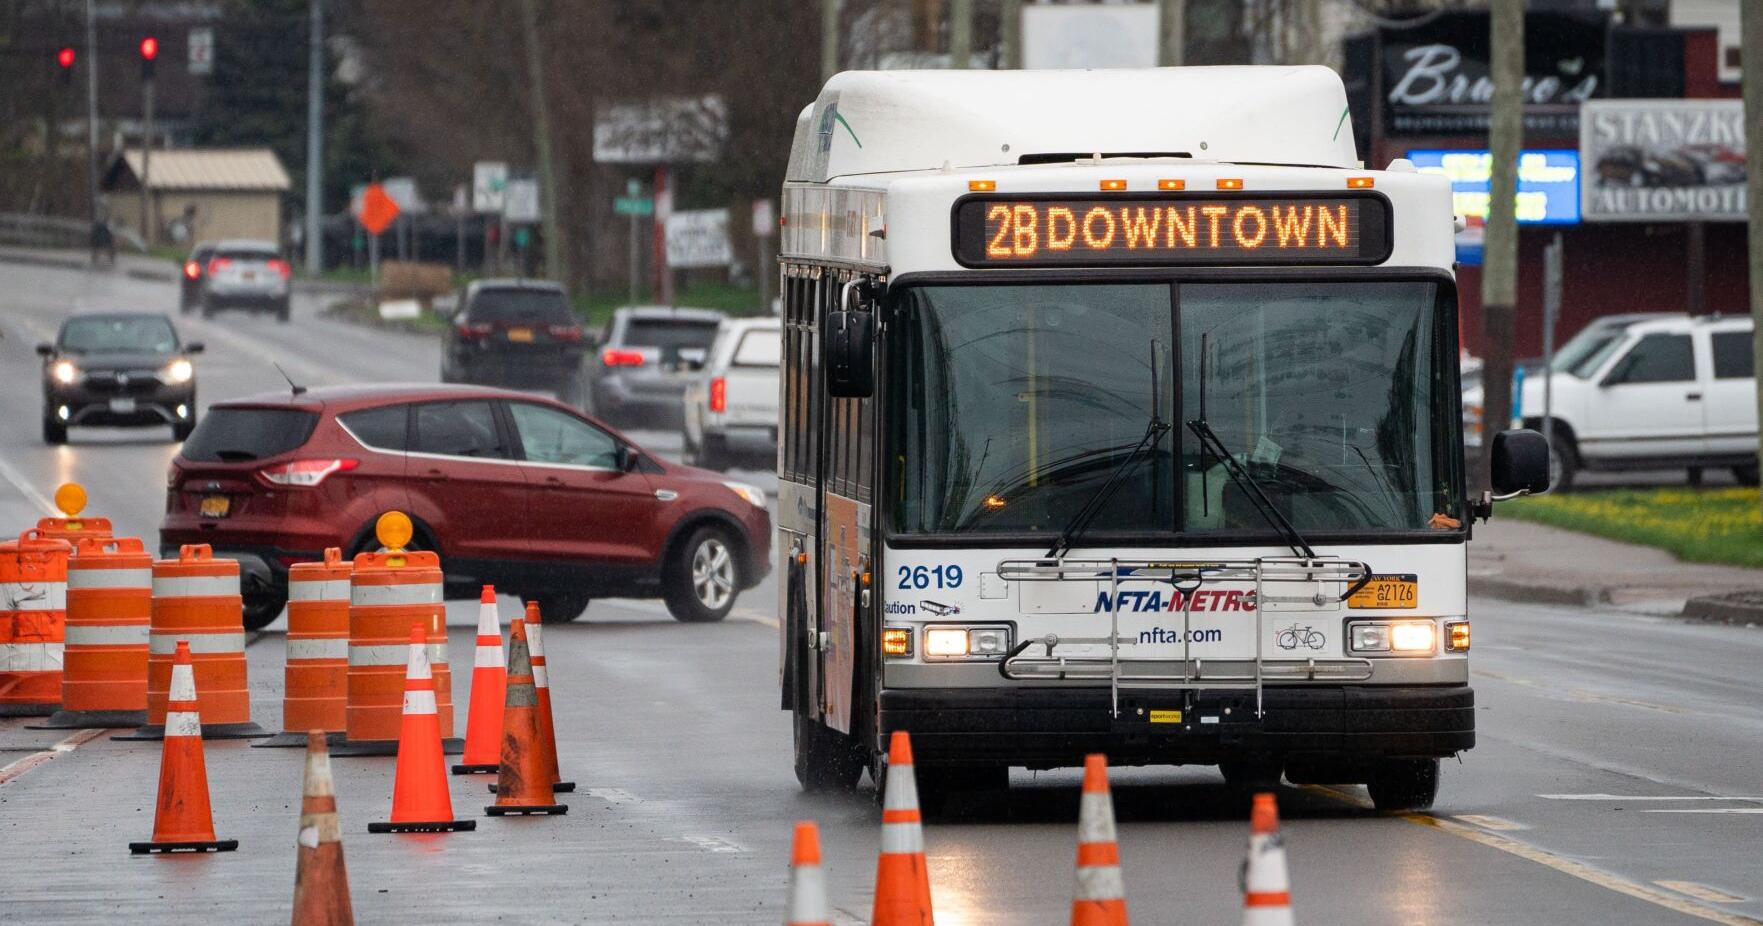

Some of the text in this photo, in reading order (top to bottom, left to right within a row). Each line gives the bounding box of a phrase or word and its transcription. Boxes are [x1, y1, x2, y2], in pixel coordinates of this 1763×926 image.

[986, 205, 1348, 256] 2B DOWNTOWN
[898, 564, 963, 589] 2619
[884, 601, 916, 614] aution
[1140, 627, 1222, 644] nfta.com
